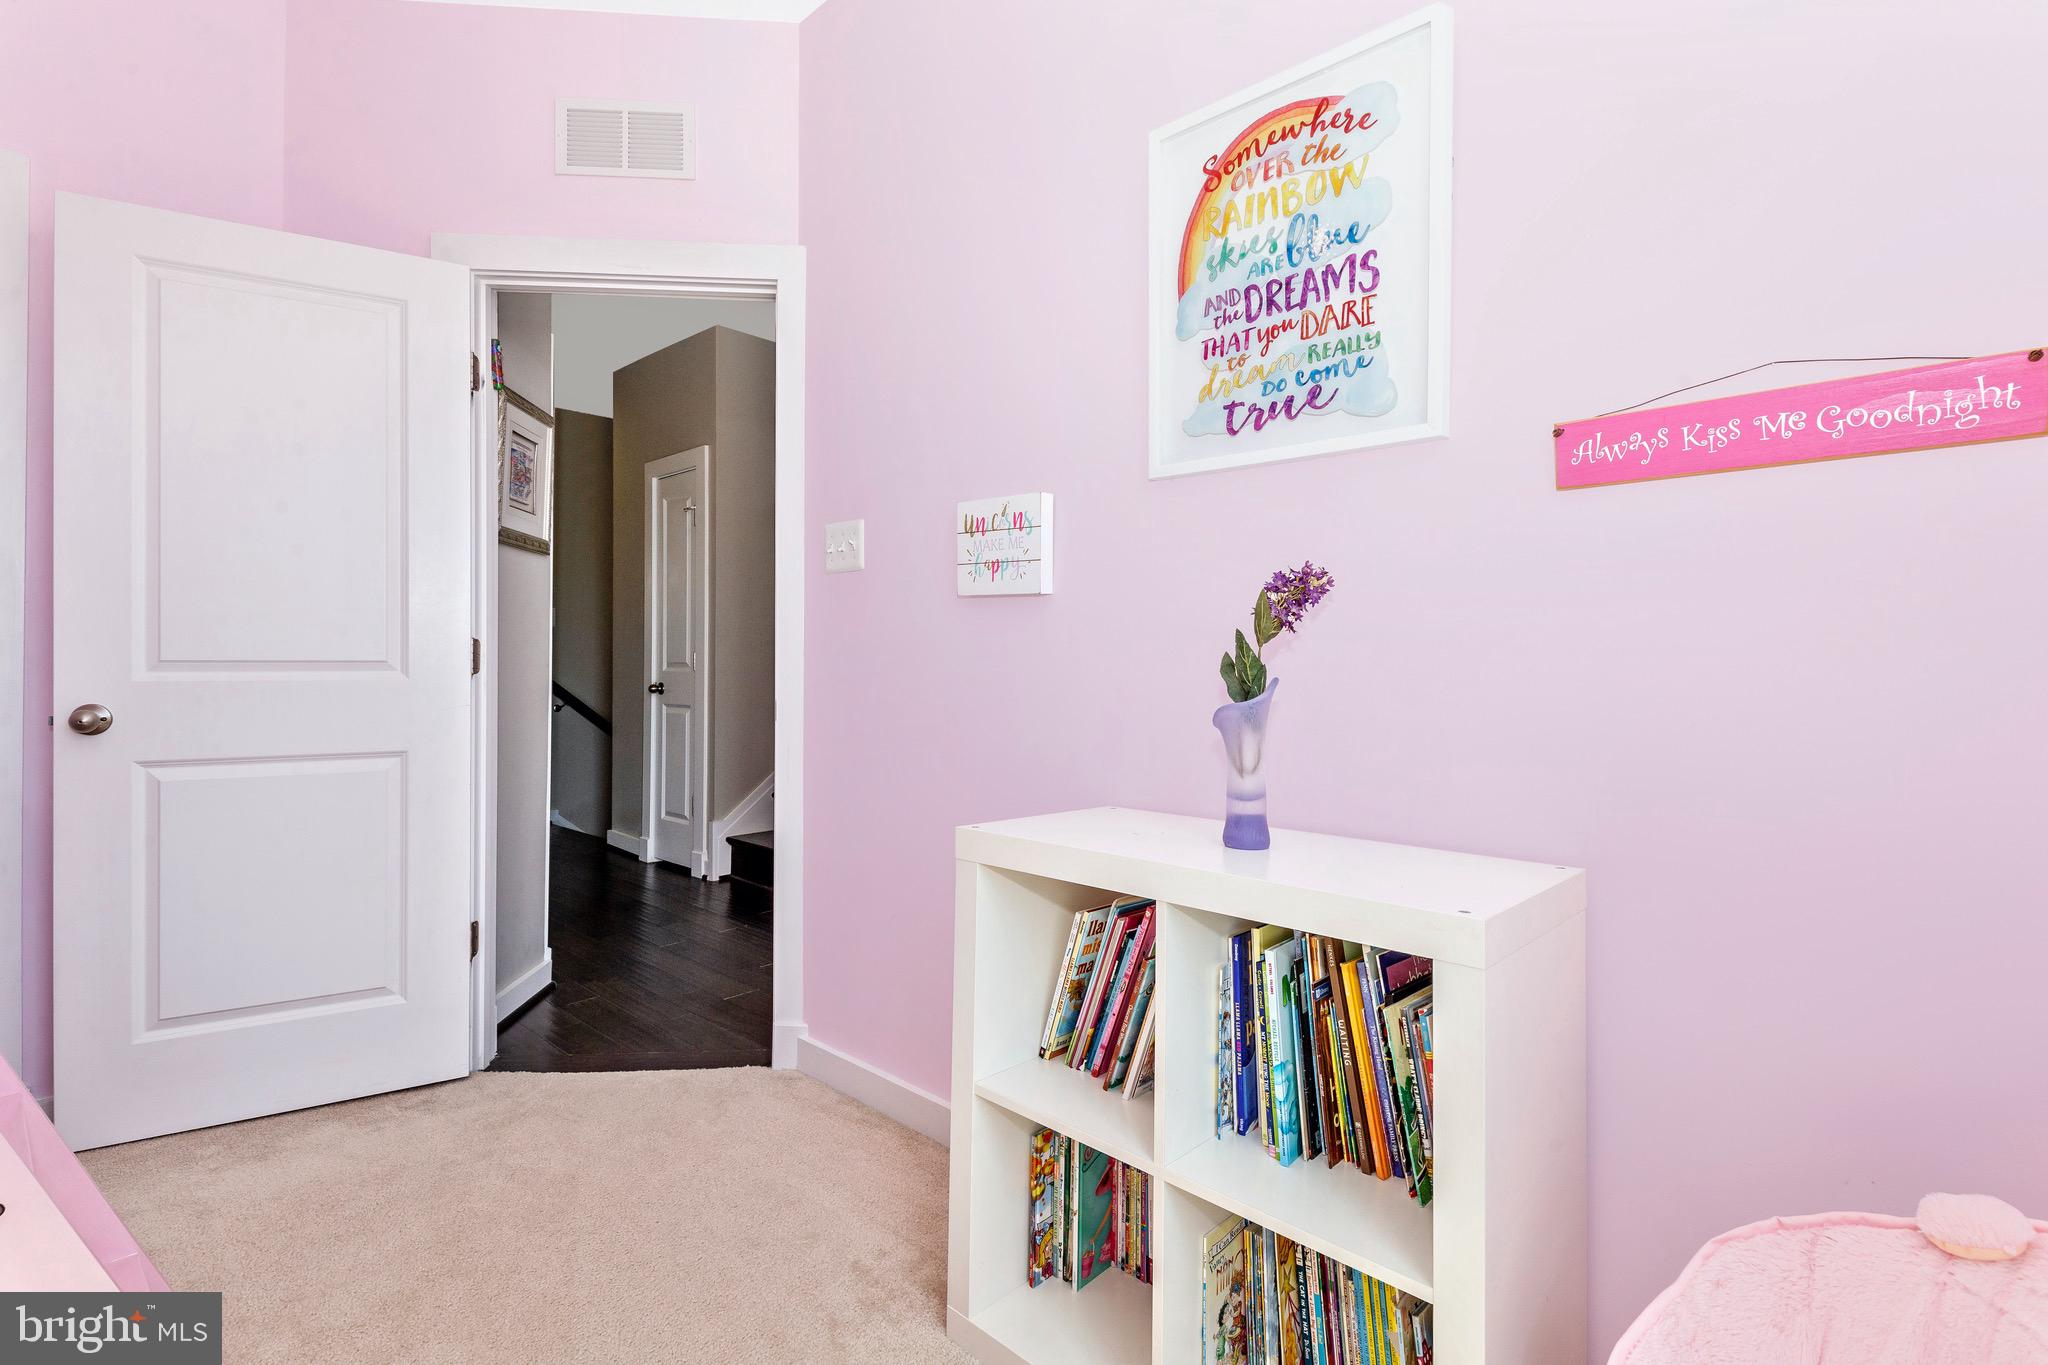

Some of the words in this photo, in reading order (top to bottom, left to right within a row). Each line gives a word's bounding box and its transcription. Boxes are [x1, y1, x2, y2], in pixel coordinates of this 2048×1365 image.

[1202, 97, 1378, 192] Somewhere
[1231, 151, 1295, 191] OVER
[1301, 134, 1348, 168] the
[1202, 154, 1371, 241] RAINBOW
[1207, 226, 1284, 282] skies
[1247, 253, 1284, 280] ARE
[1286, 213, 1371, 268] blue
[1203, 288, 1242, 318] AND
[1244, 249, 1381, 323] DREAMS
[1202, 327, 1255, 360] THAT
[1257, 320, 1299, 356] you
[1300, 294, 1378, 340] DARE
[1213, 308, 1244, 329] the
[1199, 350, 1306, 403] dream
[1308, 330, 1381, 364] REALLY
[1228, 353, 1250, 373] to
[1261, 377, 1287, 397] DO
[1296, 355, 1374, 386] come
[1223, 383, 1339, 436] true
[1571, 426, 1670, 465] Always
[1681, 417, 1742, 454] Kiss
[1754, 409, 1806, 441] Me
[1816, 375, 2022, 438] Goodnight
[974, 538, 1004, 552] MAKE
[1008, 536, 1024, 549] ME
[974, 553, 1021, 582] happy
[1261, 1031, 1265, 1040] MY
[1338, 1019, 1352, 1066] WAITING
[1371, 1036, 1380, 1055] Kissing
[1301, 1299, 1305, 1307] IN
